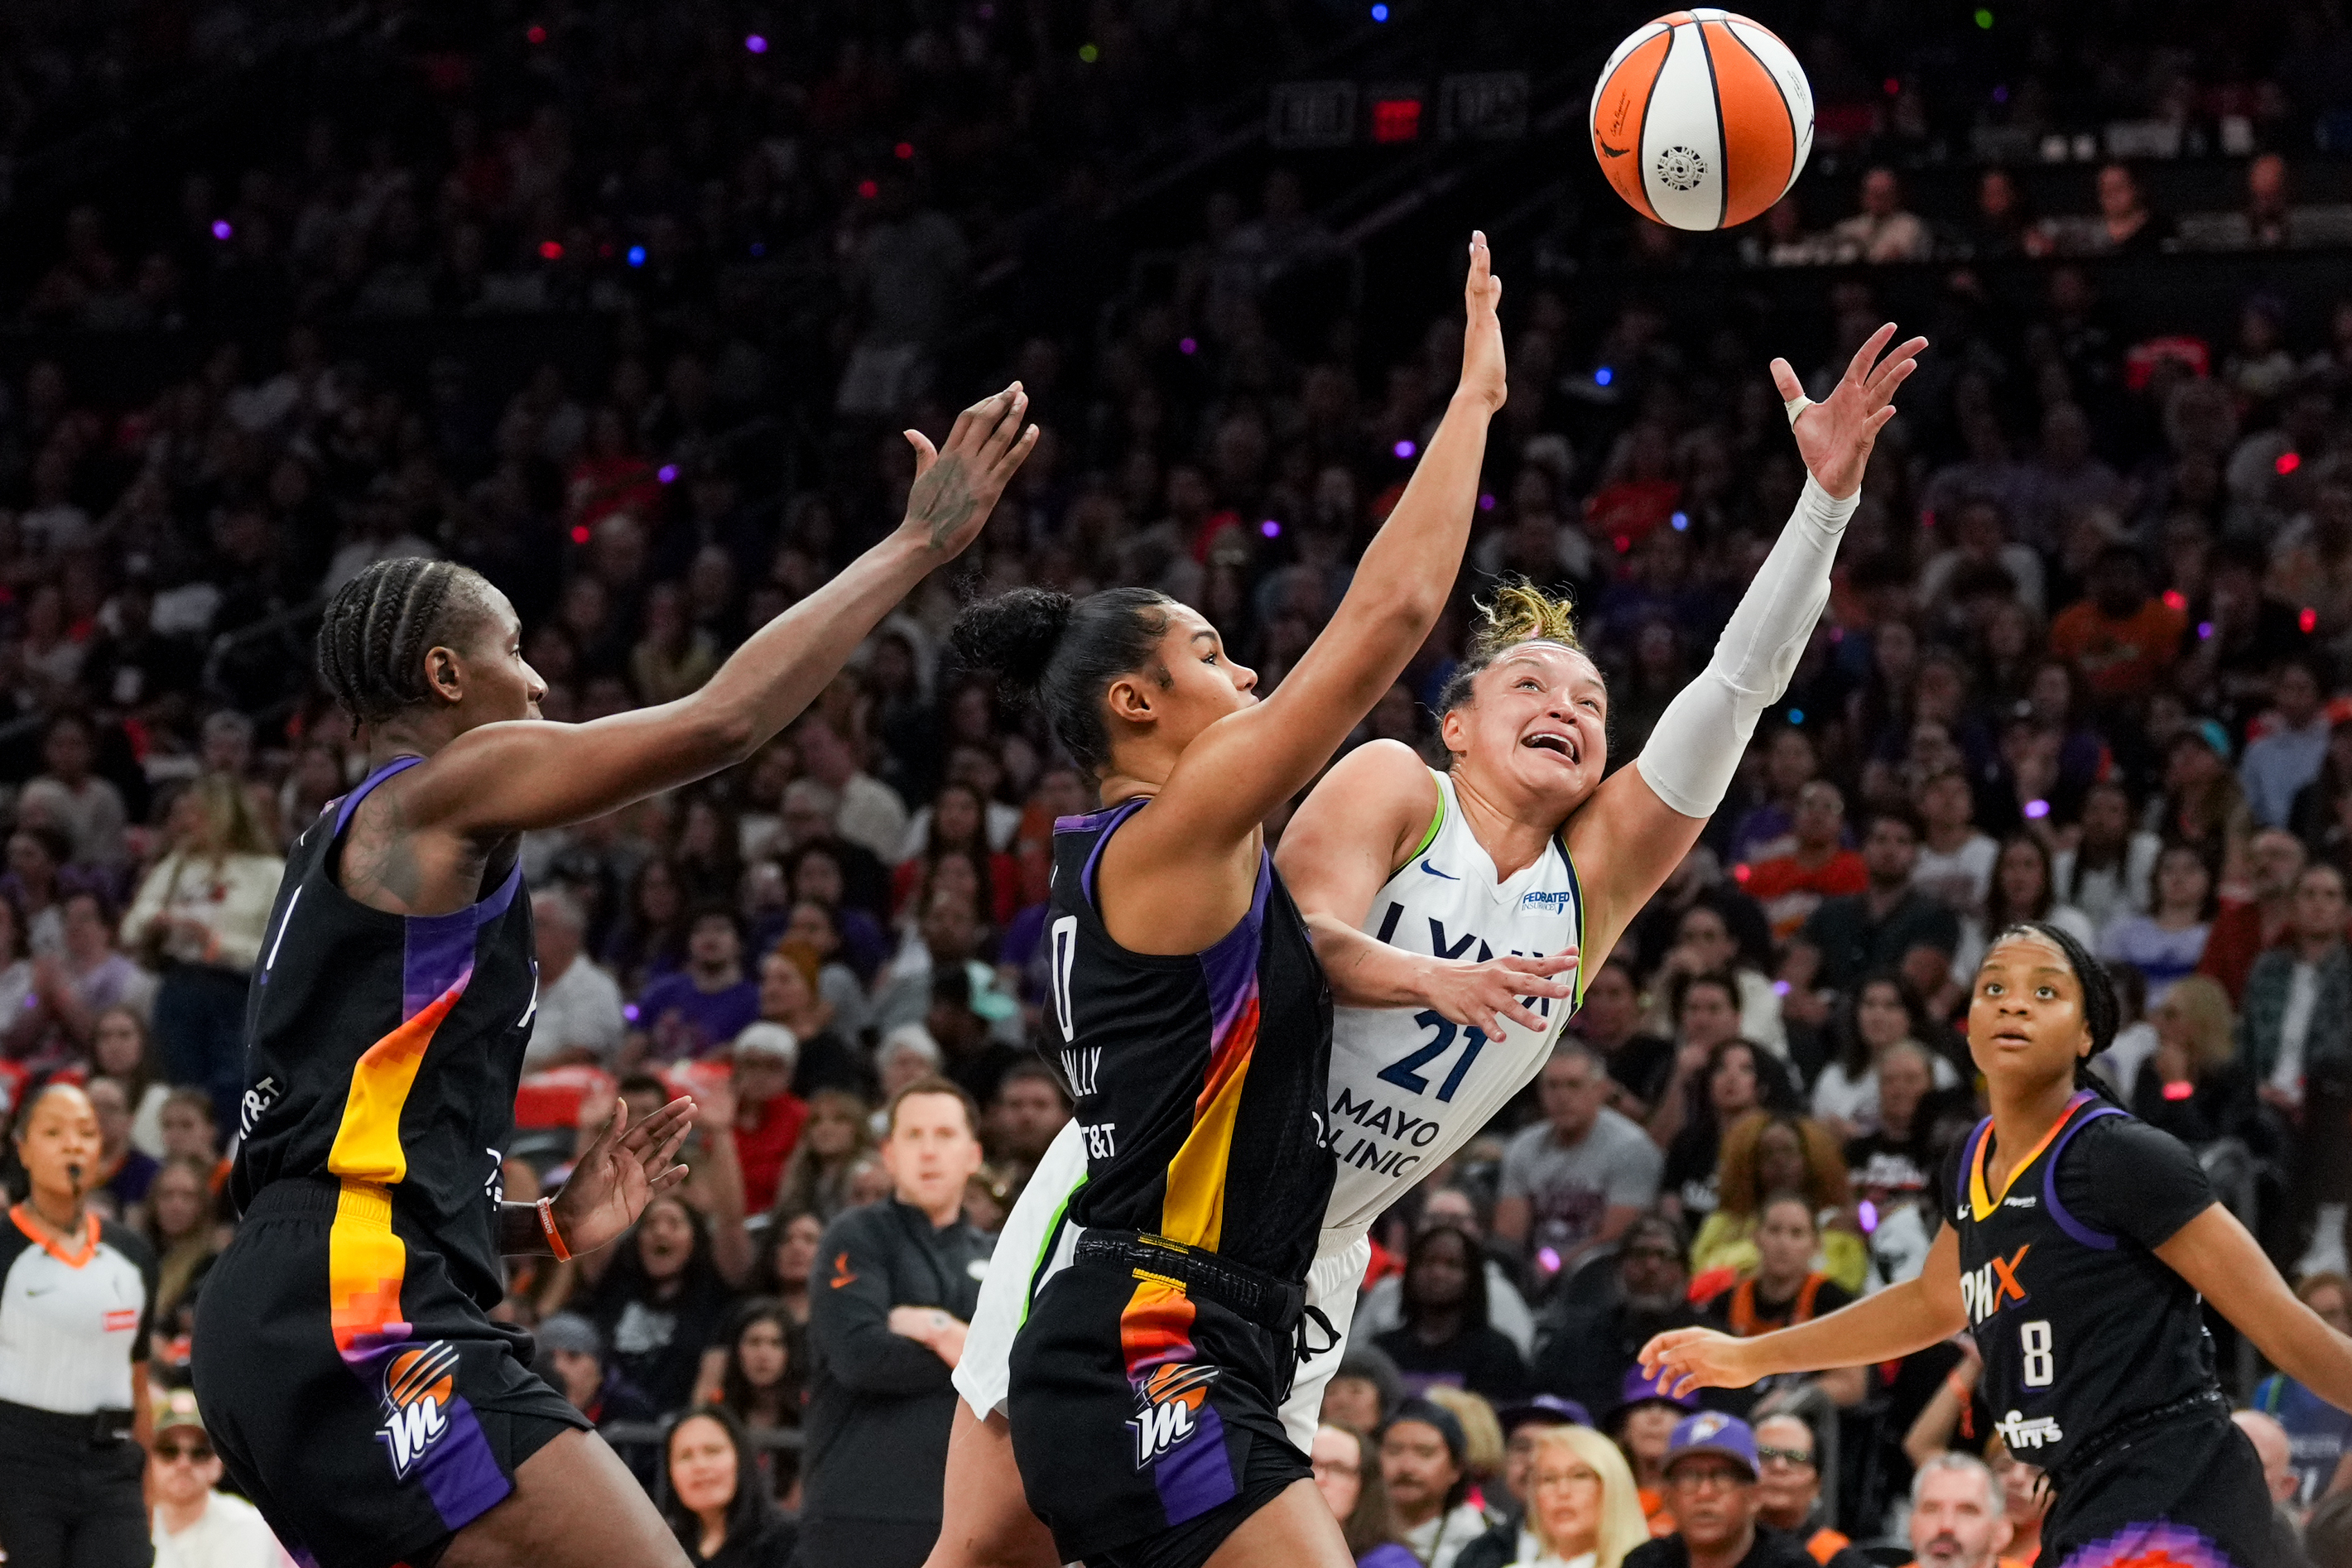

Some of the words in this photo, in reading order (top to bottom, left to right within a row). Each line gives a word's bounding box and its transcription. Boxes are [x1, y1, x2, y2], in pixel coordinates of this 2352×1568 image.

[1377, 1009, 1489, 1104] 21
[1330, 1087, 1440, 1147] MAYO
[1329, 1128, 1421, 1178] LINIC
[1959, 1243, 2031, 1325] PHX
[2021, 1320, 2054, 1386] 8
